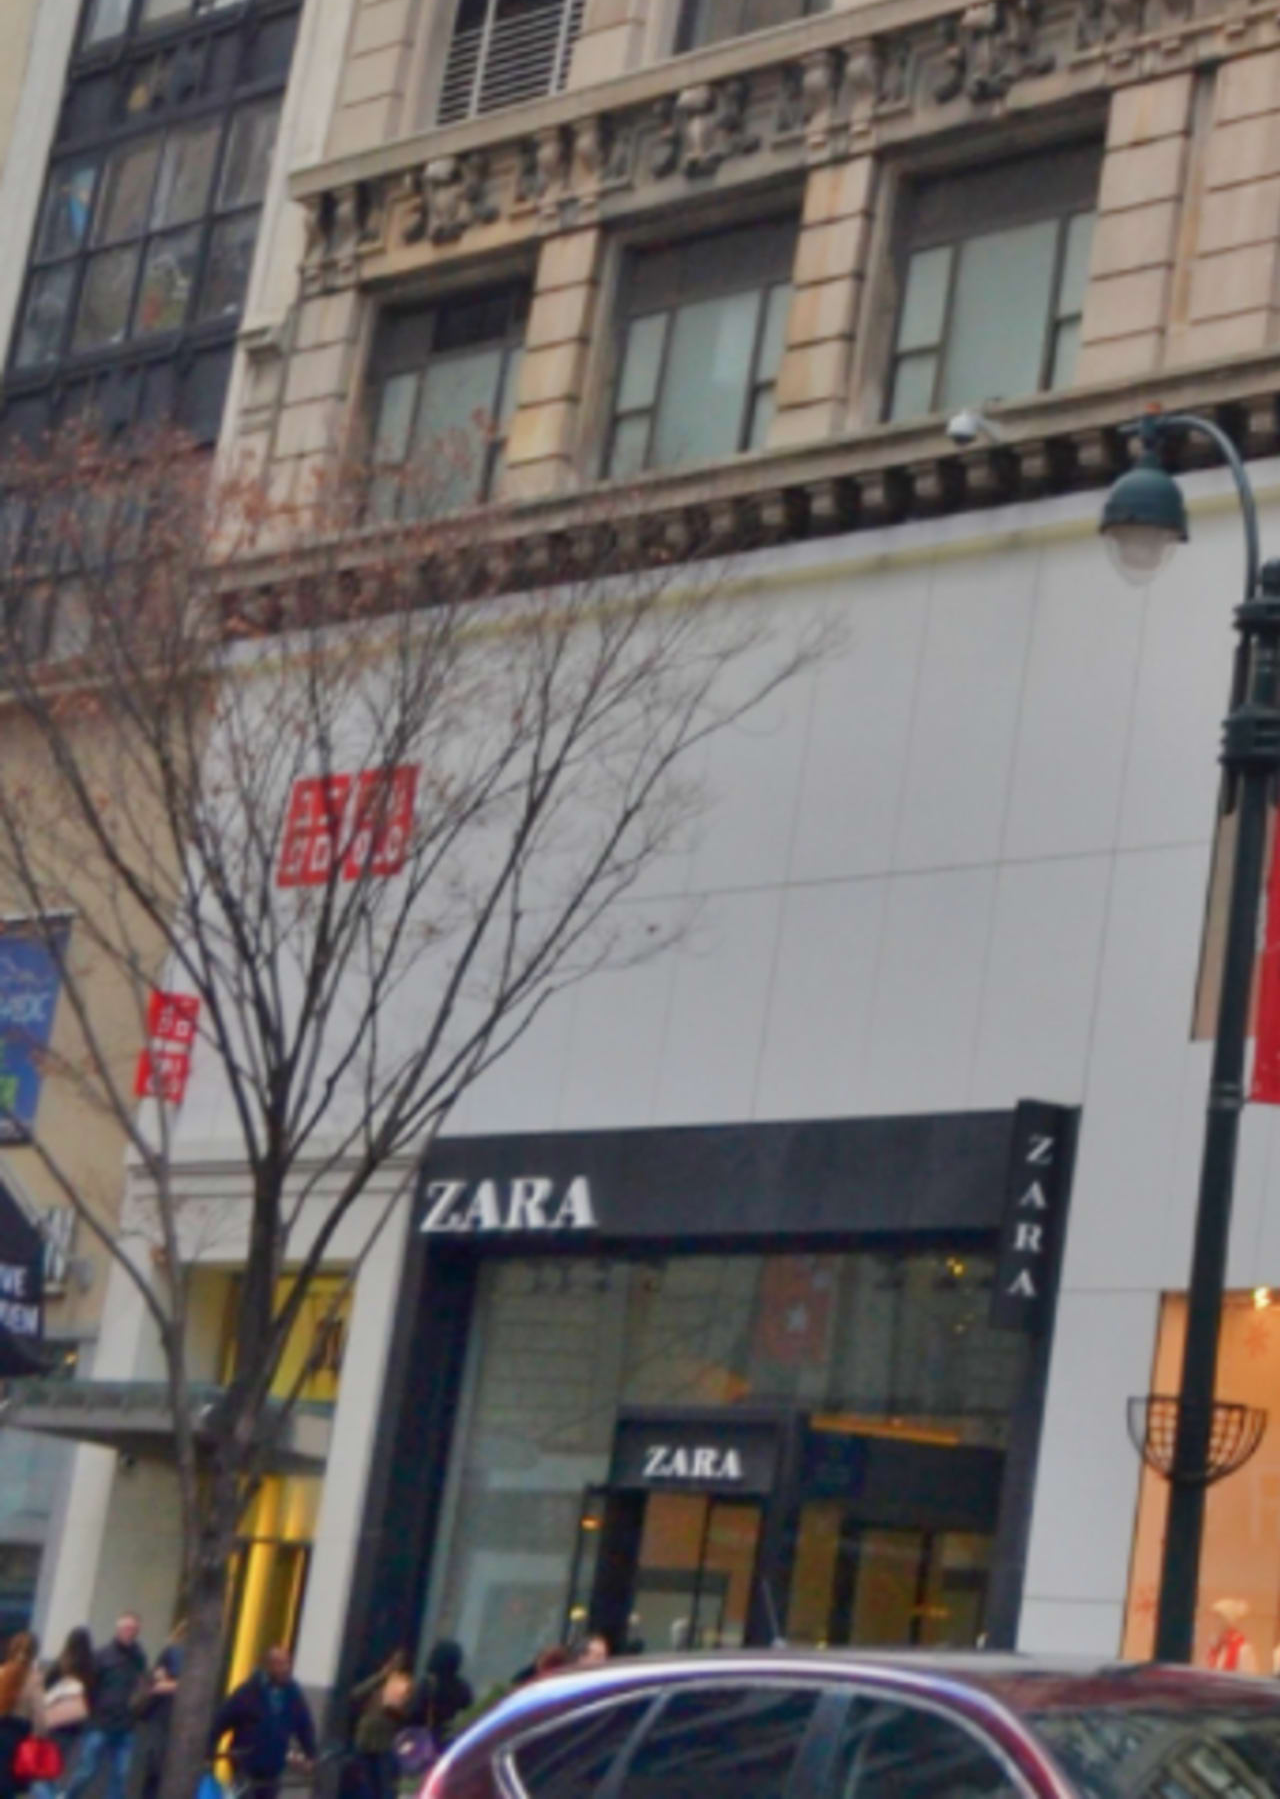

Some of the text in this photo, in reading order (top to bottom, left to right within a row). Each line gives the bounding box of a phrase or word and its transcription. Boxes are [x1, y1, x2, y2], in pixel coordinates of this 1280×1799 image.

[419, 1174, 599, 1234] ZARA
[1007, 1134, 1054, 1298] ZARA
[643, 1444, 742, 1479] ZARA
